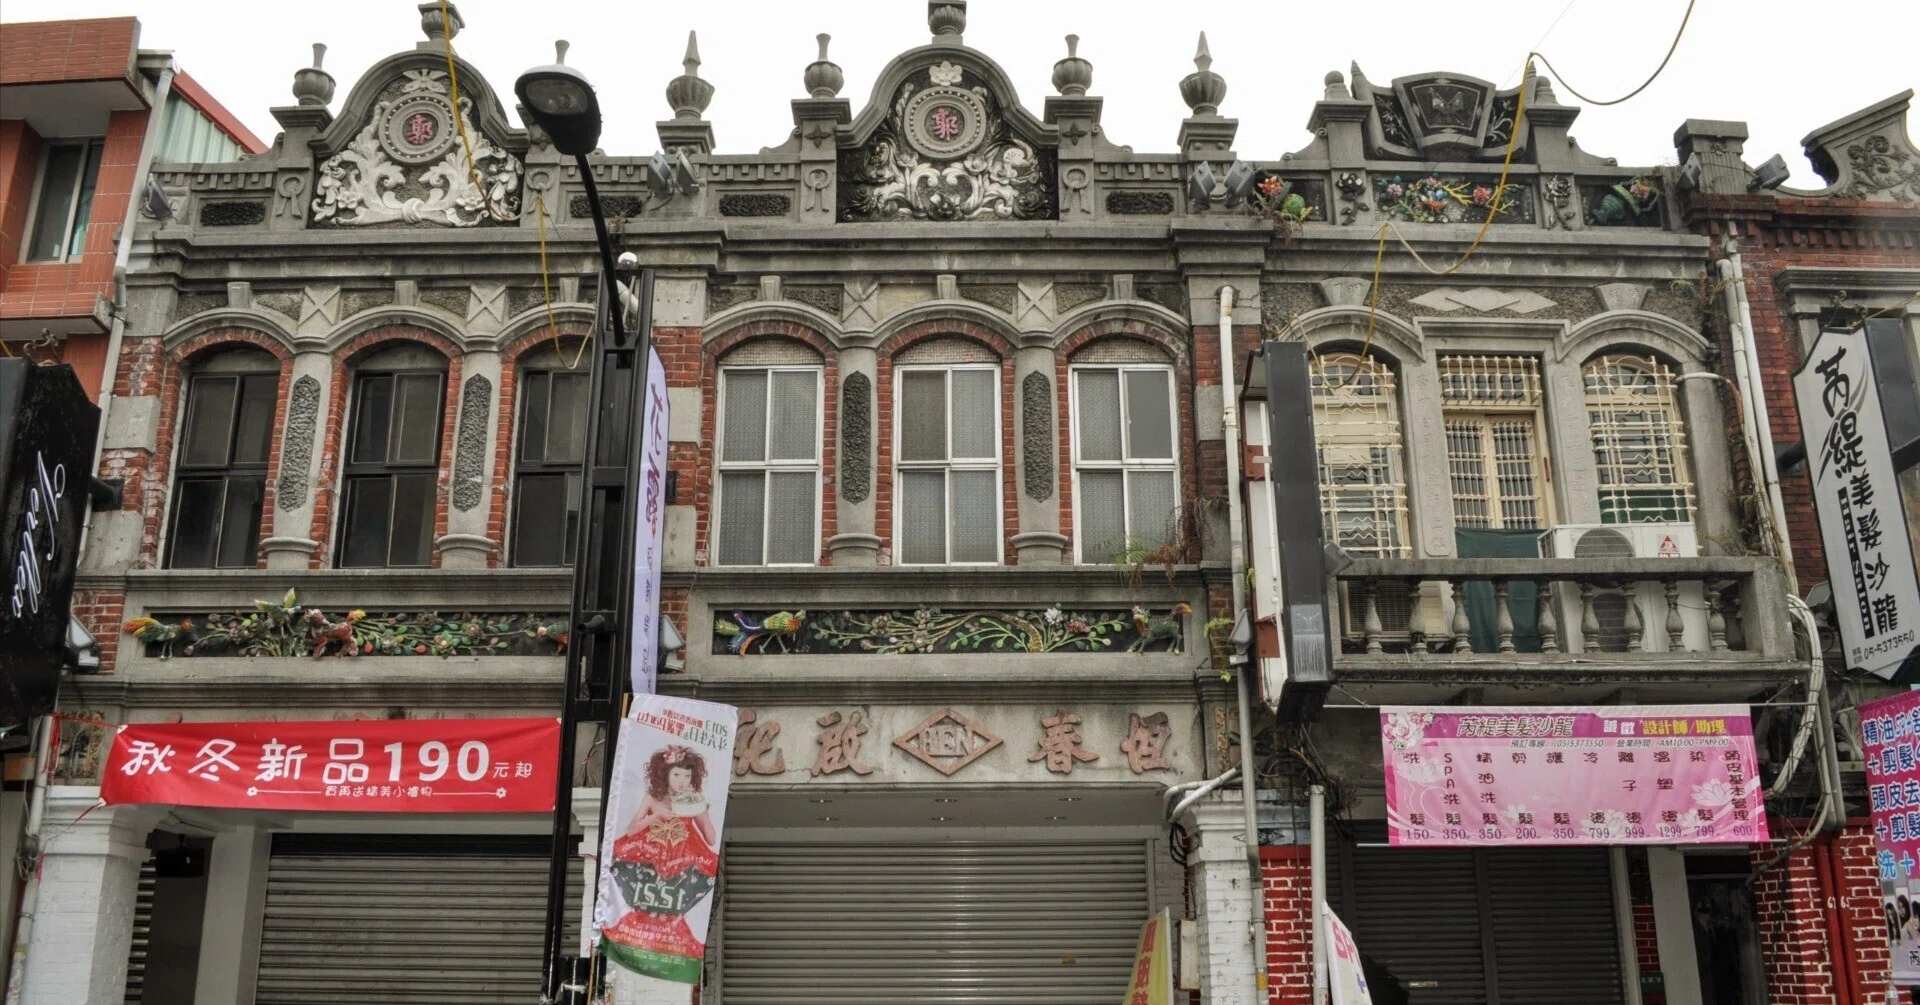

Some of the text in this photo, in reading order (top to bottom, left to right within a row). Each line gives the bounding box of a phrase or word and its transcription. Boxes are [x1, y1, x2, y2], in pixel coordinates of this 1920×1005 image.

[1864, 630, 1914, 660] 05-5373550
[1457, 716, 1575, 737] 芮緹美髮沙龍
